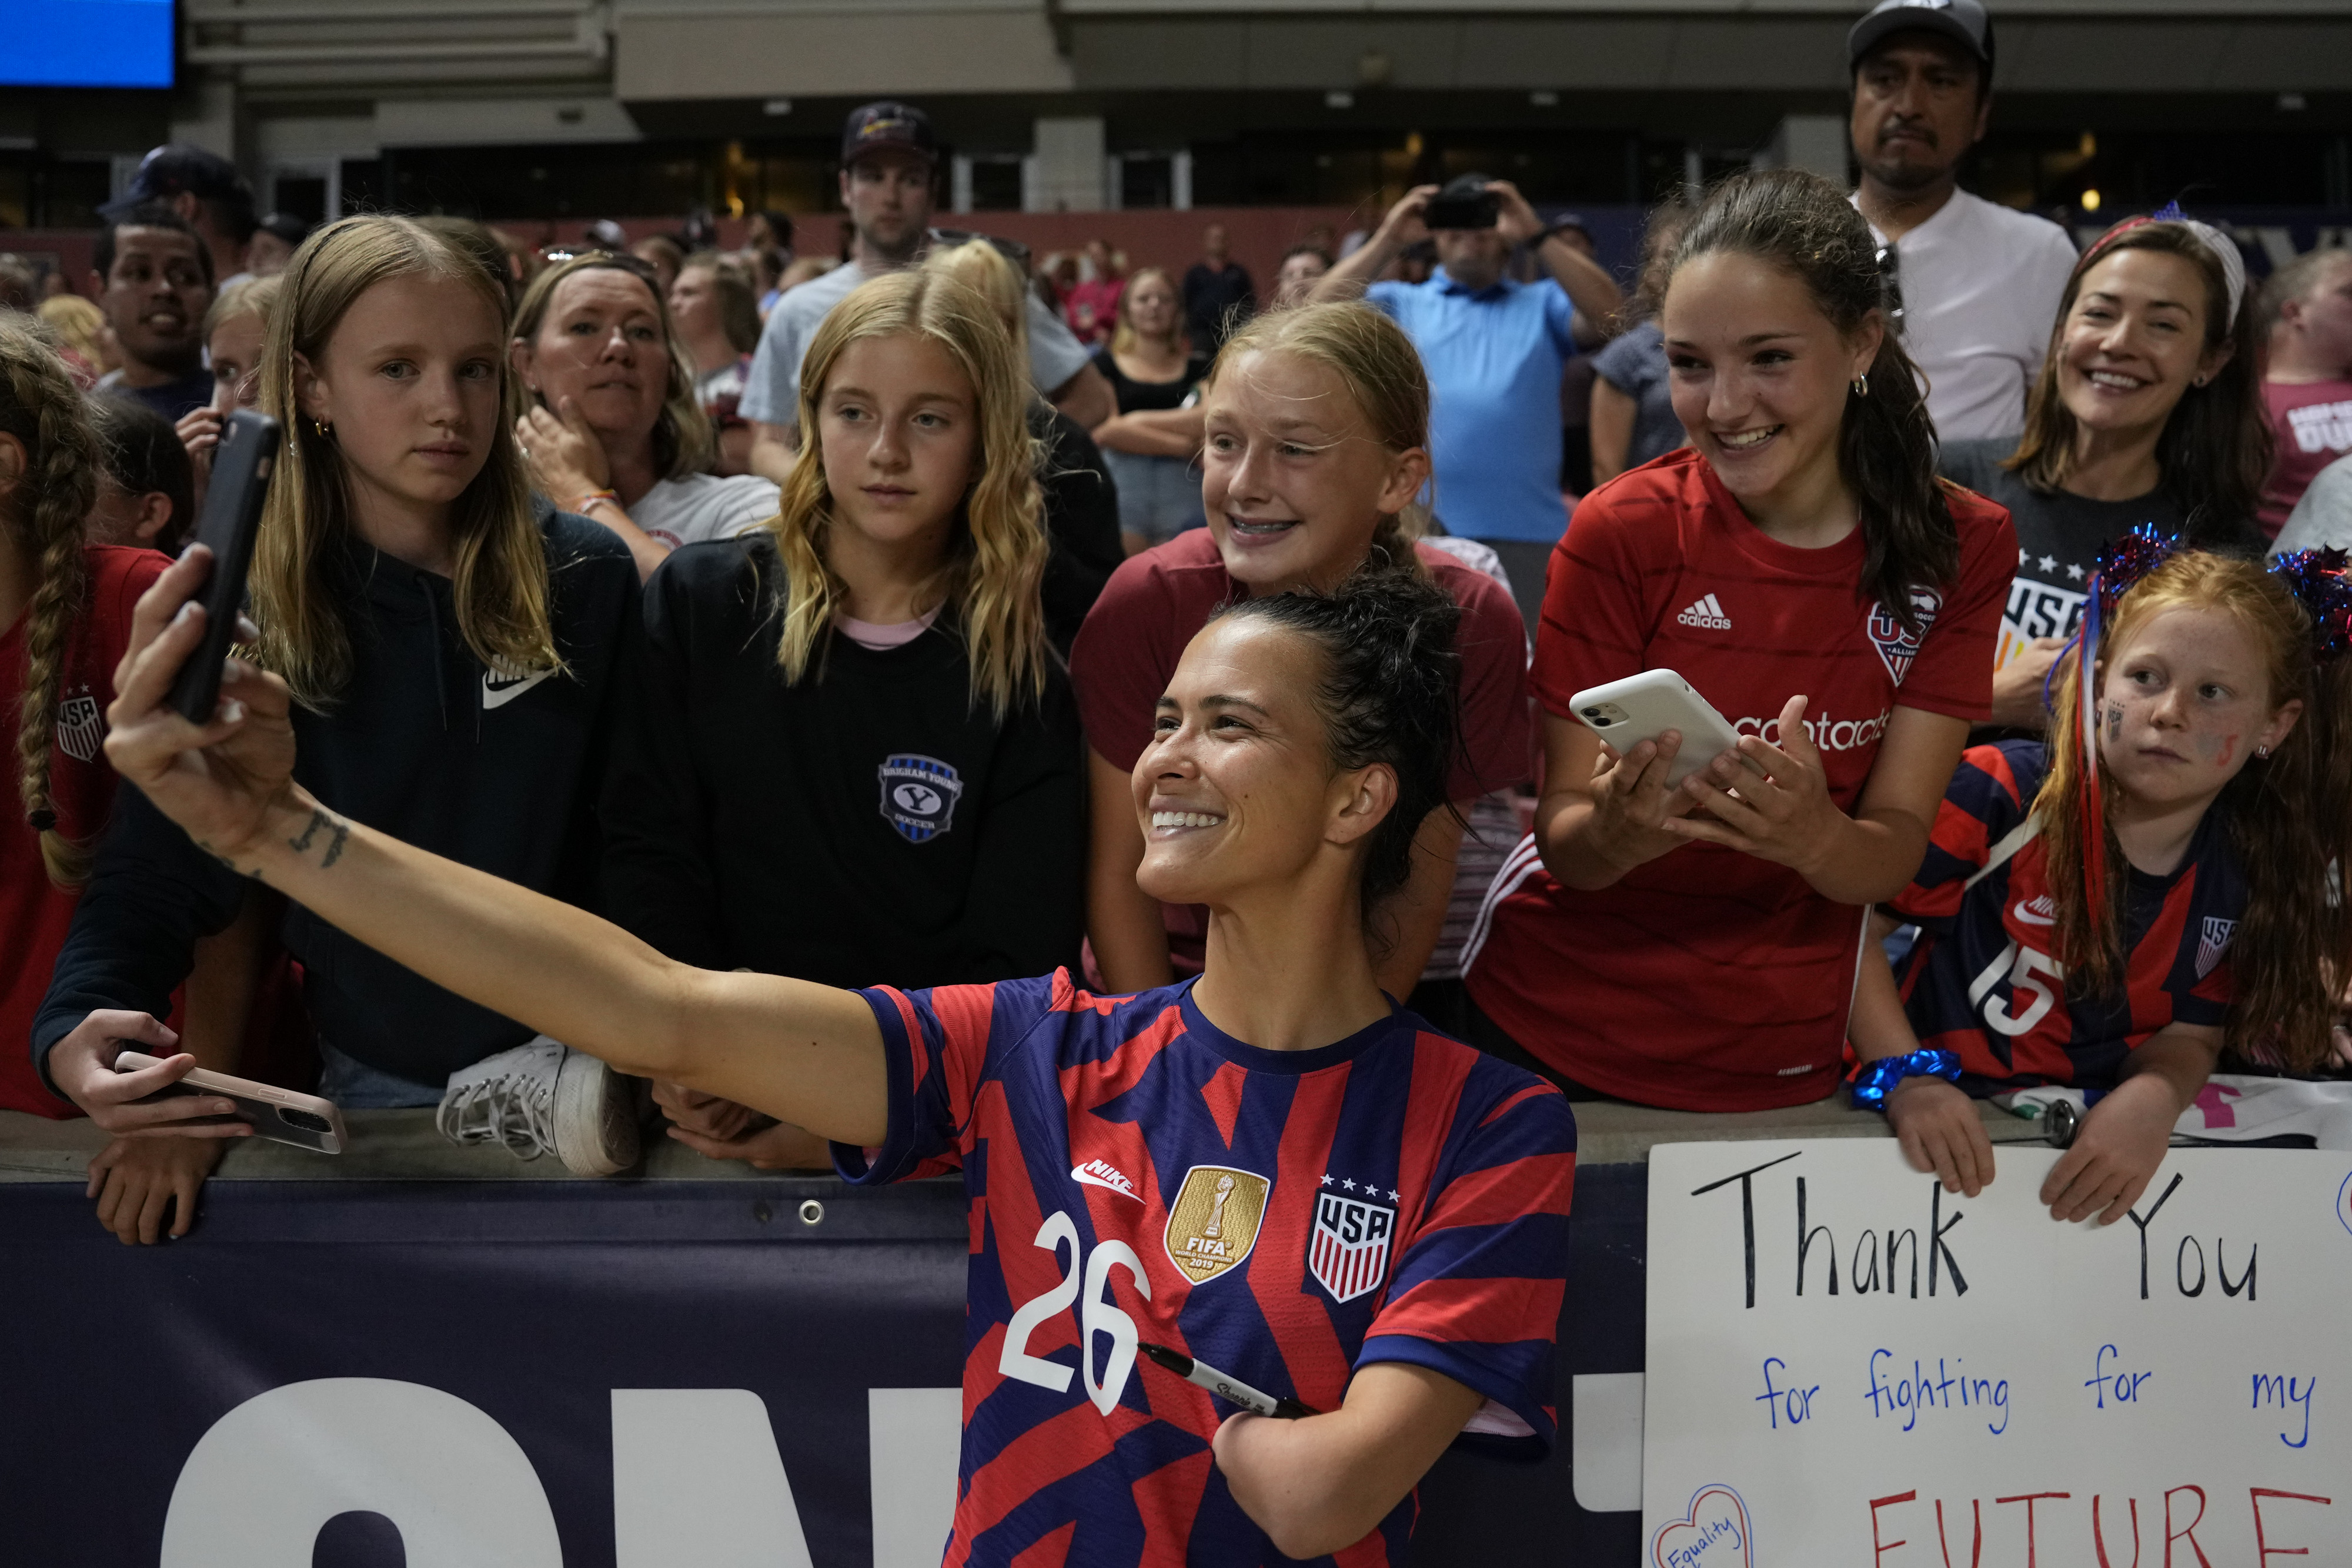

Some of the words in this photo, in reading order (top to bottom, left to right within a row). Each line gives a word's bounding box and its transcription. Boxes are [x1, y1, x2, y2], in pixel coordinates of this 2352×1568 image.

[1677, 613, 1732, 630] adidas
[883, 767, 927, 780] BRIGHAM
[929, 773, 958, 792] YOUNG
[903, 787, 933, 811] Y
[894, 813, 935, 830] SOCCER
[2028, 894, 2055, 916] NIK
[1085, 1159, 1134, 1192] NIKE
[1321, 1198, 1390, 1243] USA
[1690, 1150, 1969, 1309] Thank
[2115, 1172, 2257, 1301] You
[1175, 1249, 1197, 1258] WORLD
[1198, 1252, 1234, 1263] CHAMPIONS
[1189, 1258, 1214, 1269] 2019
[998, 1210, 1152, 1416] 26
[1755, 1357, 1820, 1429] for
[1865, 1348, 2009, 1435] fighting
[2084, 1343, 2152, 1409] for
[2252, 1373, 2316, 1448] my
[1668, 1516, 1741, 1568] Equality
